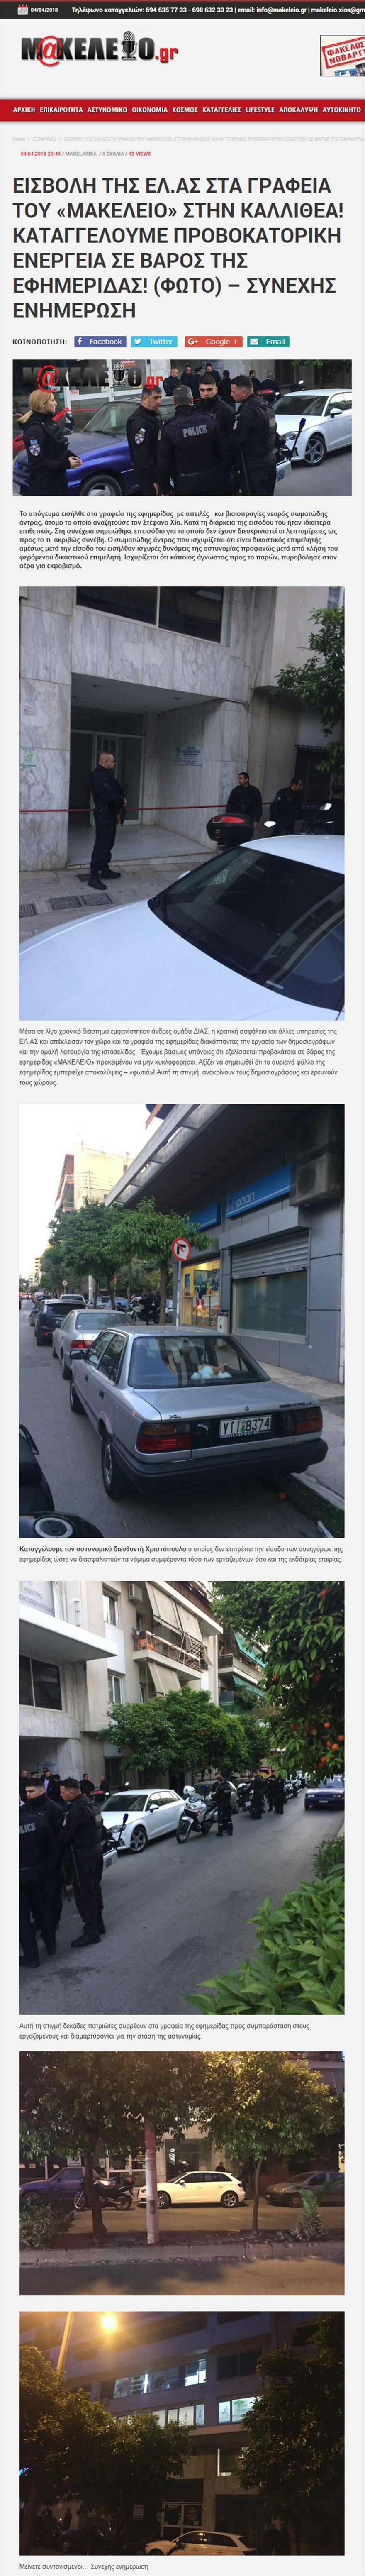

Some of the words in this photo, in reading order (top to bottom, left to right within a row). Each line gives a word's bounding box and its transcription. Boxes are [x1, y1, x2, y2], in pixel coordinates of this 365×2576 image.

[327, 41, 365, 56] ΦΑΚΕΛΟΣ
[14, 178, 96, 193] ΕΙΣΒΟΛΗ
[102, 178, 139, 193] ΤΗΣ
[146, 178, 200, 193] ΕΛ.ΑΣ
[206, 178, 242, 193] ΣΤΑ
[248, 178, 331, 193] ΓΡΑΦΕΙΑ
[12, 203, 51, 218] ΤΟΥ
[57, 203, 177, 218] «ΜΑΚΕΛΕΙΟ»
[183, 203, 234, 218] ΣΤΗΝ
[241, 203, 343, 218] ΚΑΛΛΙΘΕΑ!
[14, 228, 168, 243] ΚΑΤΑΓΓΕΛΟΥΜΕ
[174, 228, 340, 243] ΠΡΟΒΟΚΑΤΟΡΙΚΗ
[14, 253, 106, 268] ΕΝΕΡΓΕΙΑ
[112, 253, 134, 268] ΣΕ
[141, 253, 204, 268] ΒΑΡΟΣ
[210, 253, 248, 268] ΤΗΣ
[14, 278, 147, 293] ΕΦΗΜΕΡΙΔΑΣ!
[154, 276, 221, 297] (ΦΩΤΟ)
[247, 278, 336, 293] ΣΥΝΕΧΗΣ
[14, 303, 135, 318] ΕΝΗΜΕΡΩΣΗ
[182, 425, 207, 437] POLICE
[24, 1586, 42, 1599] ΚΕΝΤΡΟ
